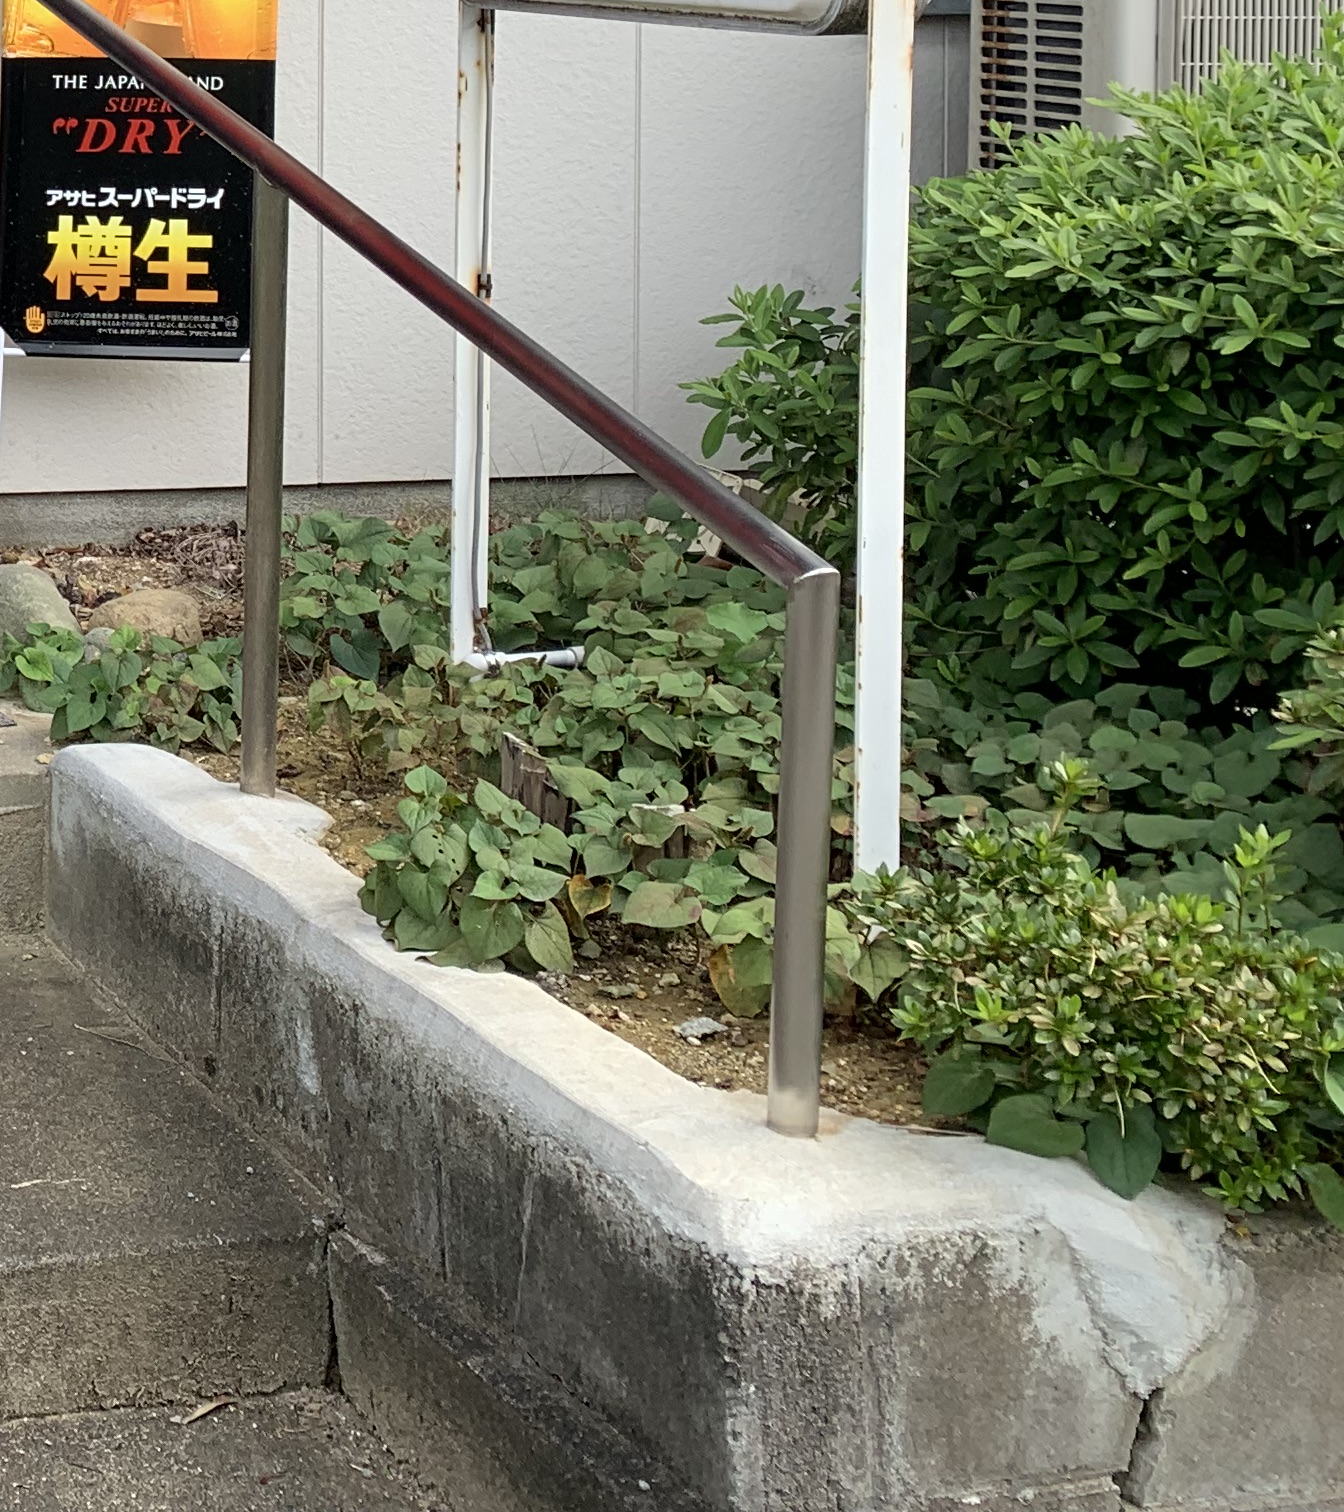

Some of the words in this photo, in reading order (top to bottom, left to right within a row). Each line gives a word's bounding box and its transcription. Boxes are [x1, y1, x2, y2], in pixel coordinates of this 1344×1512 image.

[52, 75, 88, 89] THE
[94, 75, 145, 90] JAPA
[43, 214, 219, 304] 樽生
